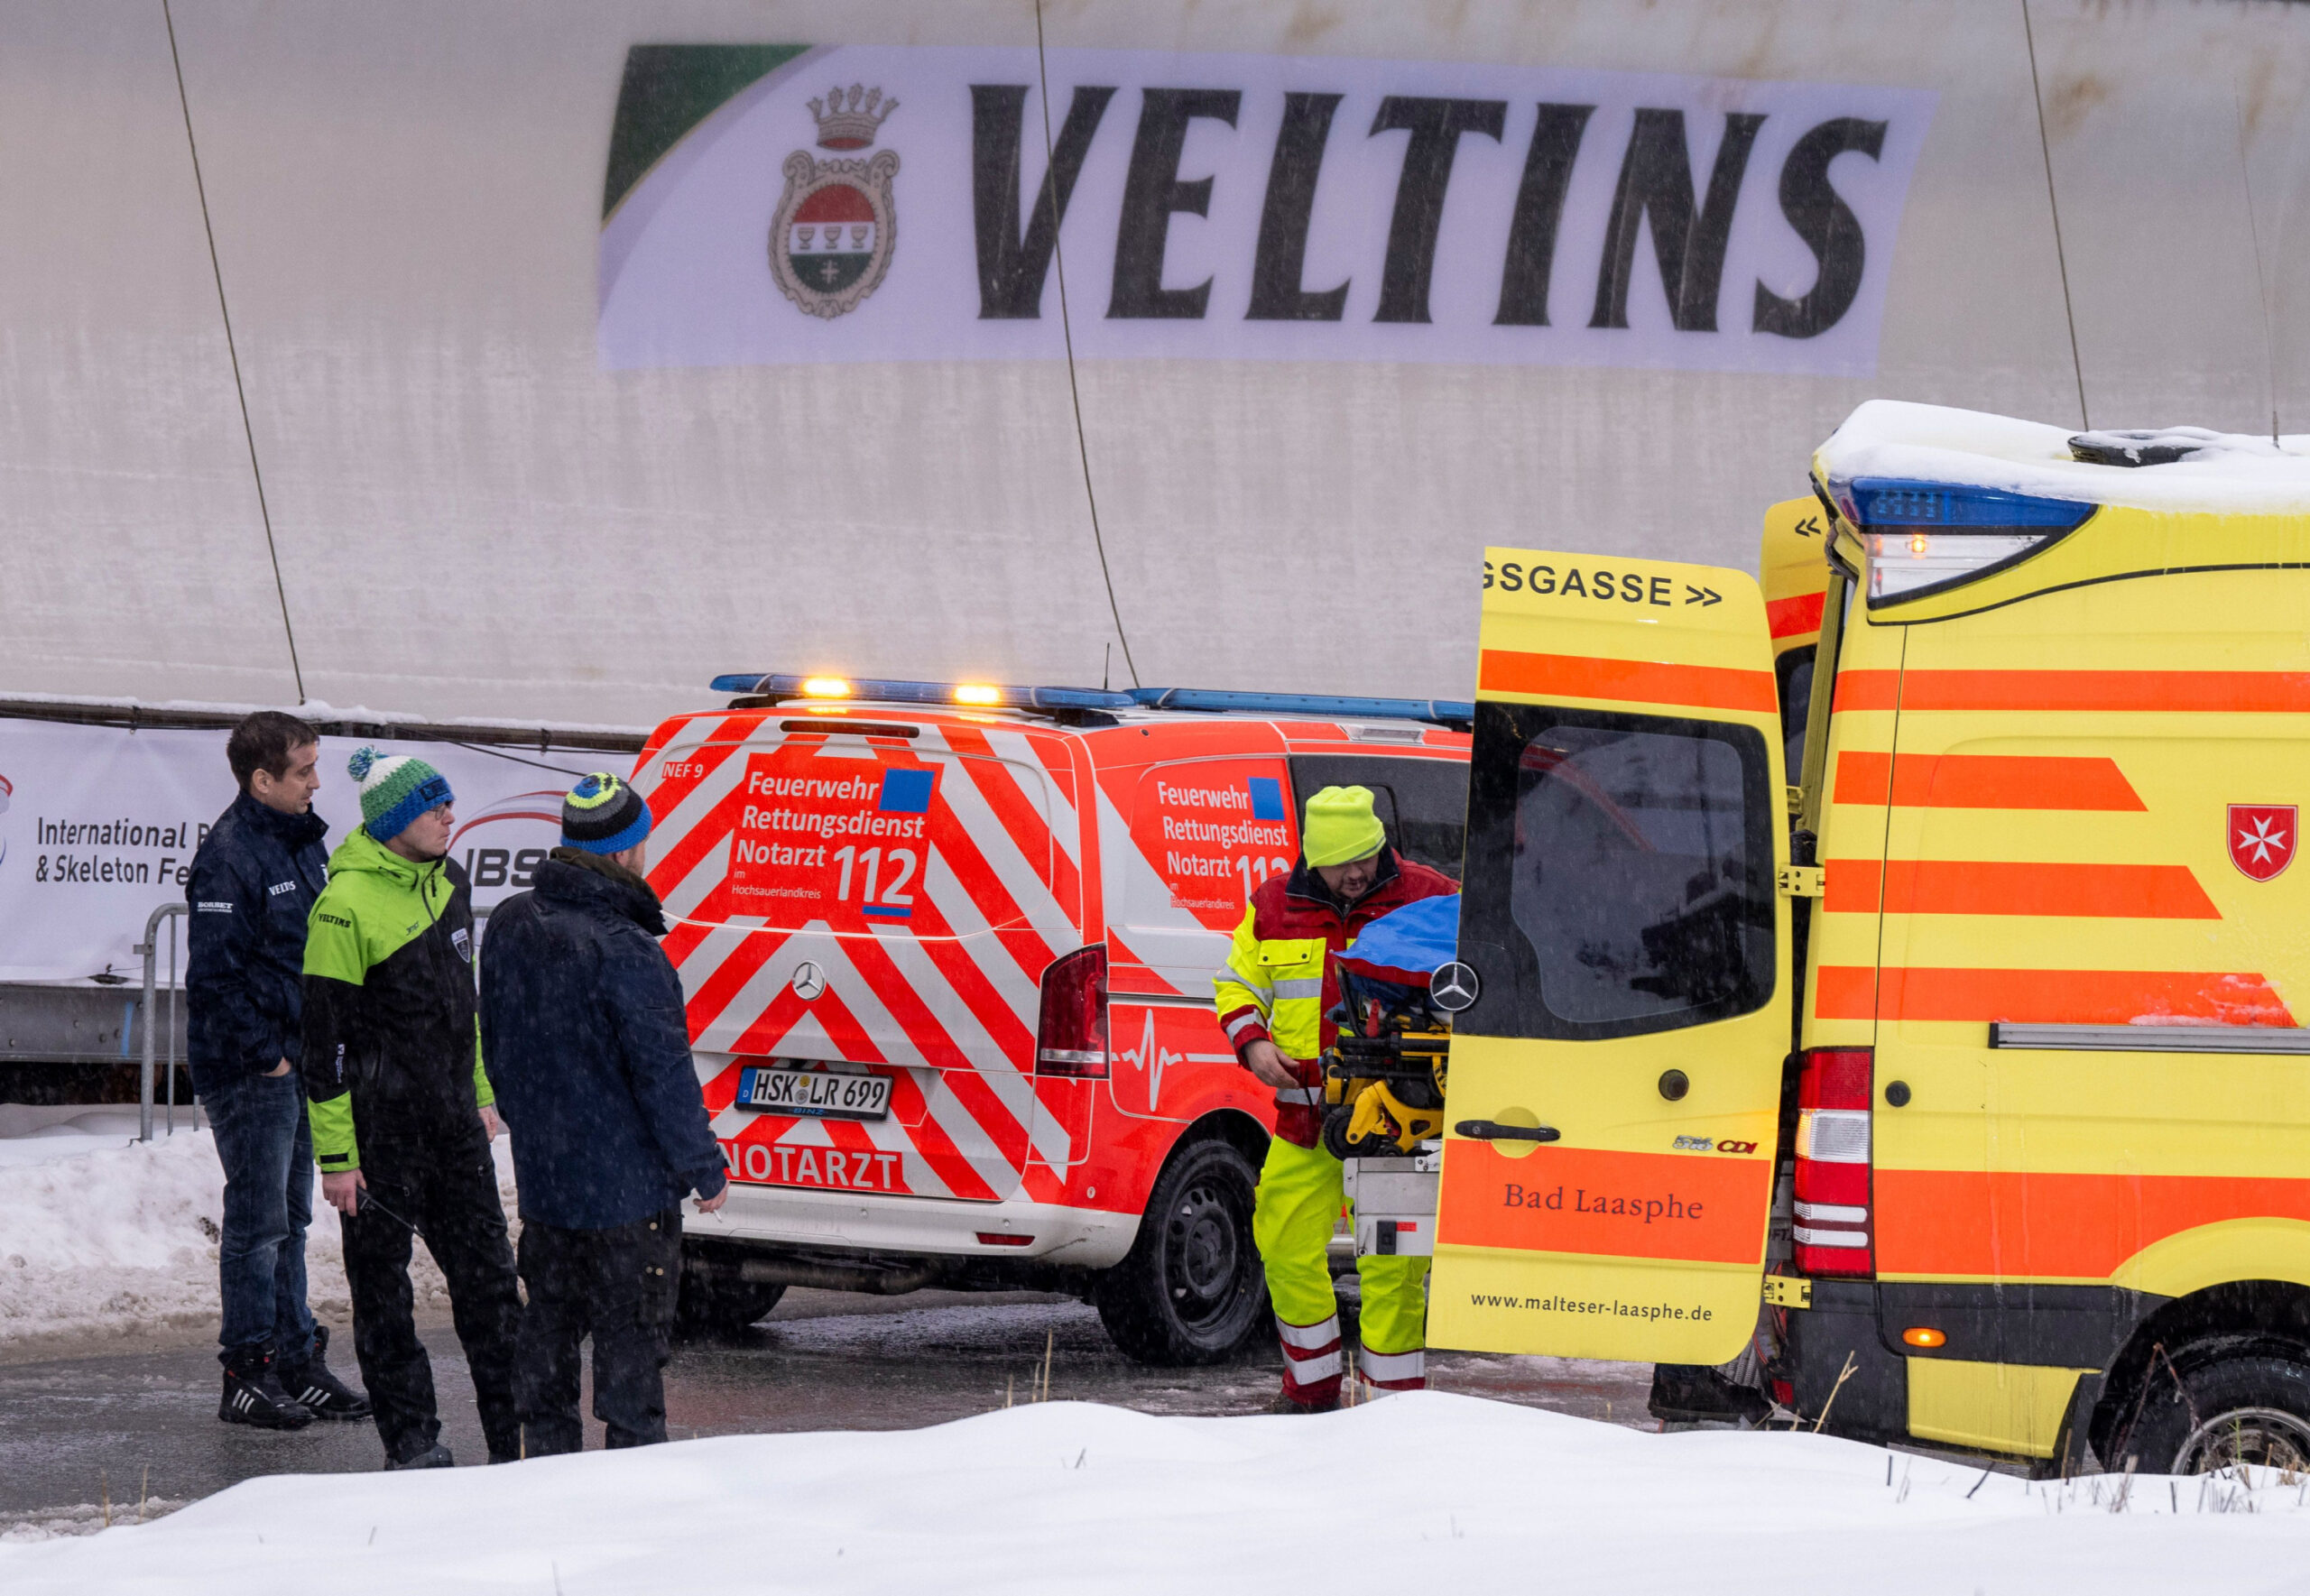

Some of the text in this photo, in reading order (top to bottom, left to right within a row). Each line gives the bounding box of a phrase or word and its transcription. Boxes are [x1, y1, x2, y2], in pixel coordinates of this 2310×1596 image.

[968, 82, 1889, 340] VELTINS
[662, 763, 704, 779] NEF 9
[748, 771, 879, 800] Feuerwehr
[1157, 781, 1249, 810] Feuerwehr
[38, 816, 186, 850] International
[742, 806, 925, 839] Rettungsdienst
[1162, 816, 1289, 850] Rettungsdienst
[736, 839, 826, 868] Notarzt
[1167, 851, 1232, 878] Notarzt
[35, 854, 50, 882] &
[53, 853, 149, 884] Skeleton
[734, 870, 745, 879] im
[833, 845, 918, 906] 112
[732, 884, 821, 899] Hochsauerlandkreis
[742, 1090, 750, 1098] D
[753, 1073, 885, 1109] HSK LR 699
[1716, 1139, 1759, 1154] CDI
[716, 1141, 898, 1189] NOTARZT
[1503, 1184, 1704, 1224] Bad Laasphe
[1471, 1294, 1713, 1322] www.malteser-laasphe.de
